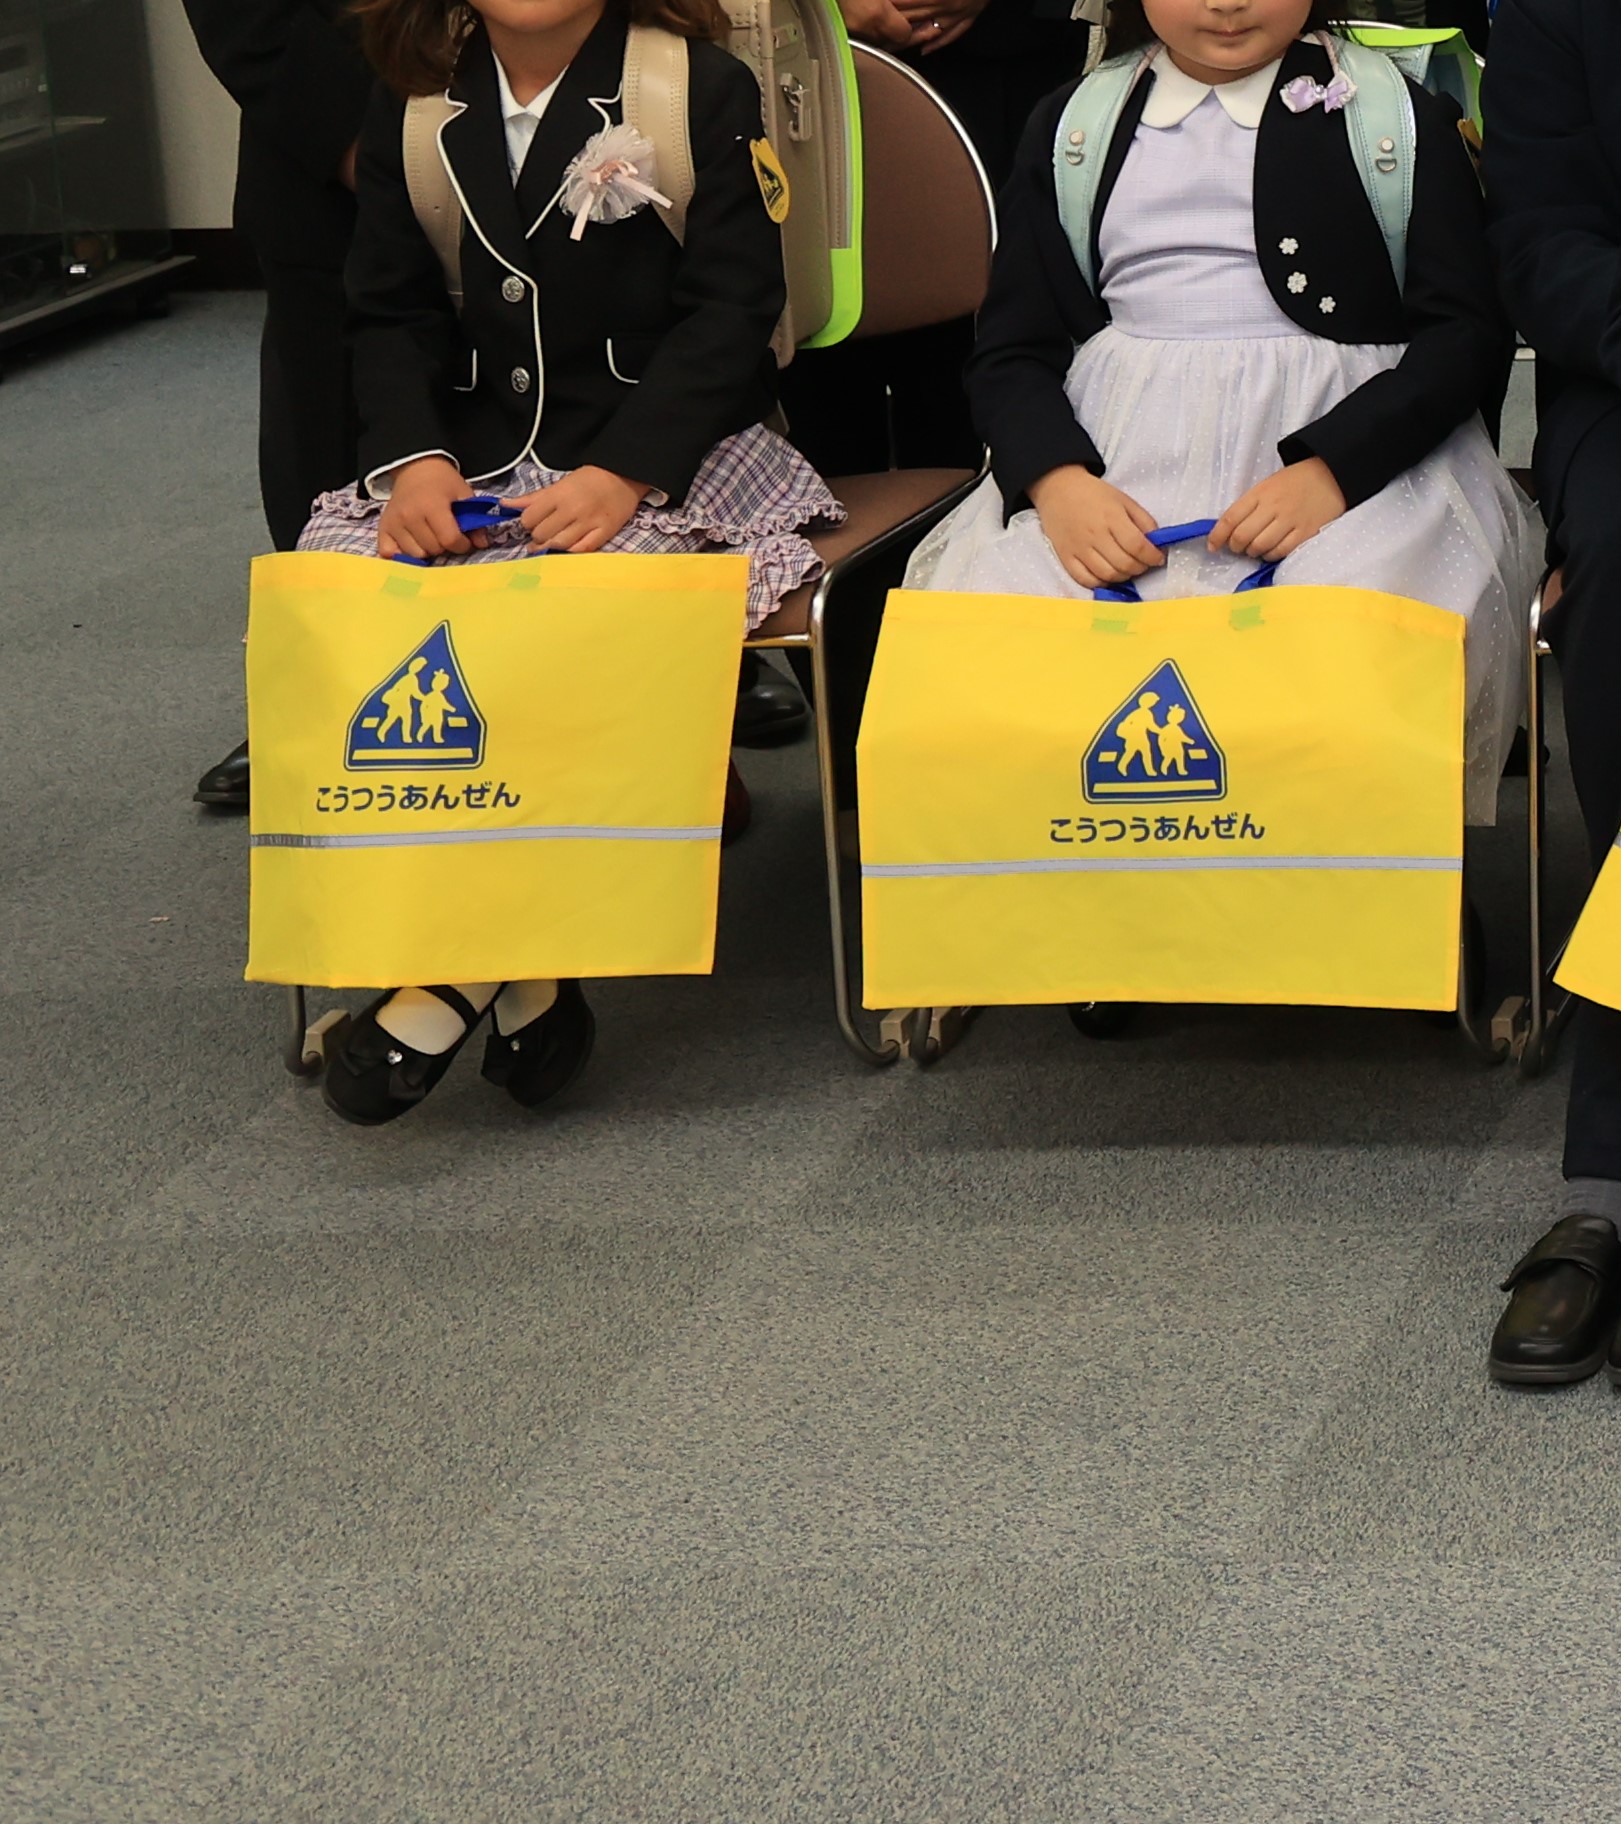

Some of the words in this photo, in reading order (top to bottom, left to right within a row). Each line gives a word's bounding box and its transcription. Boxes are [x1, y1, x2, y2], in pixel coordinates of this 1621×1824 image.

[316, 780, 521, 813] こうつうあんぜん
[1050, 811, 1266, 844] こうつうあんぜん
